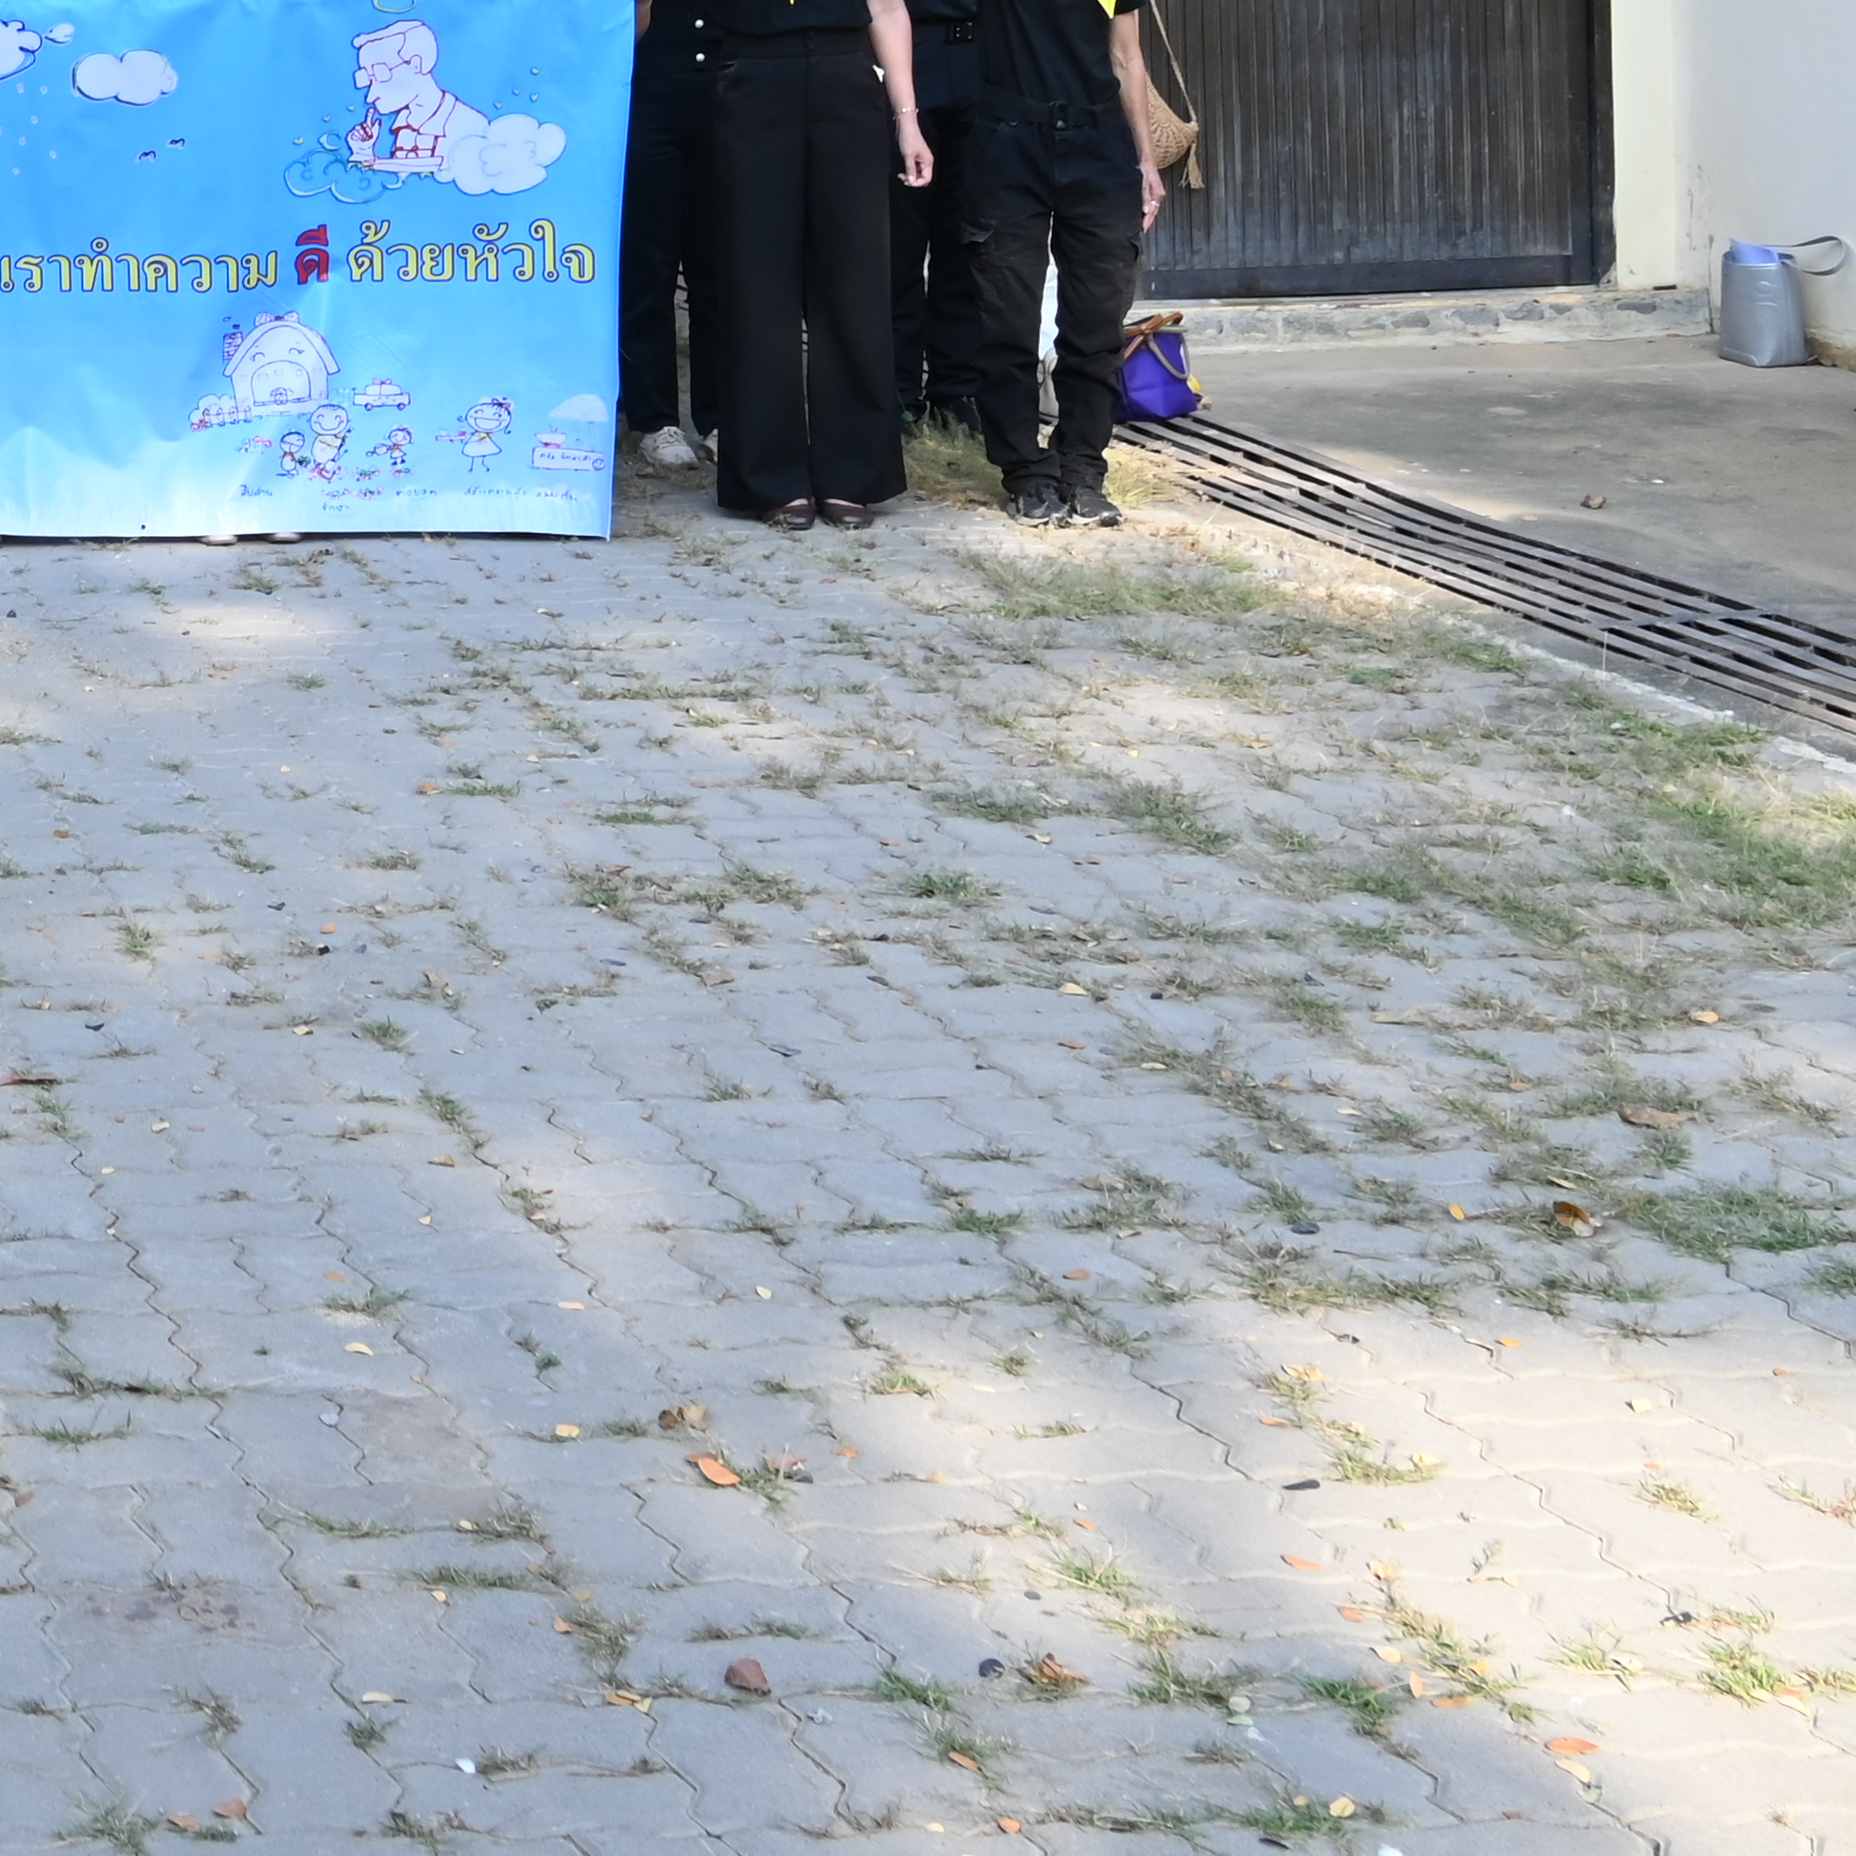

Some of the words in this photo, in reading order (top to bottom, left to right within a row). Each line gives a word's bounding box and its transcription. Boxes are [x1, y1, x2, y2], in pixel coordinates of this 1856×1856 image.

[294, 224, 330, 285] ดี
[347, 219, 597, 285] ด้วยหัวใจ
